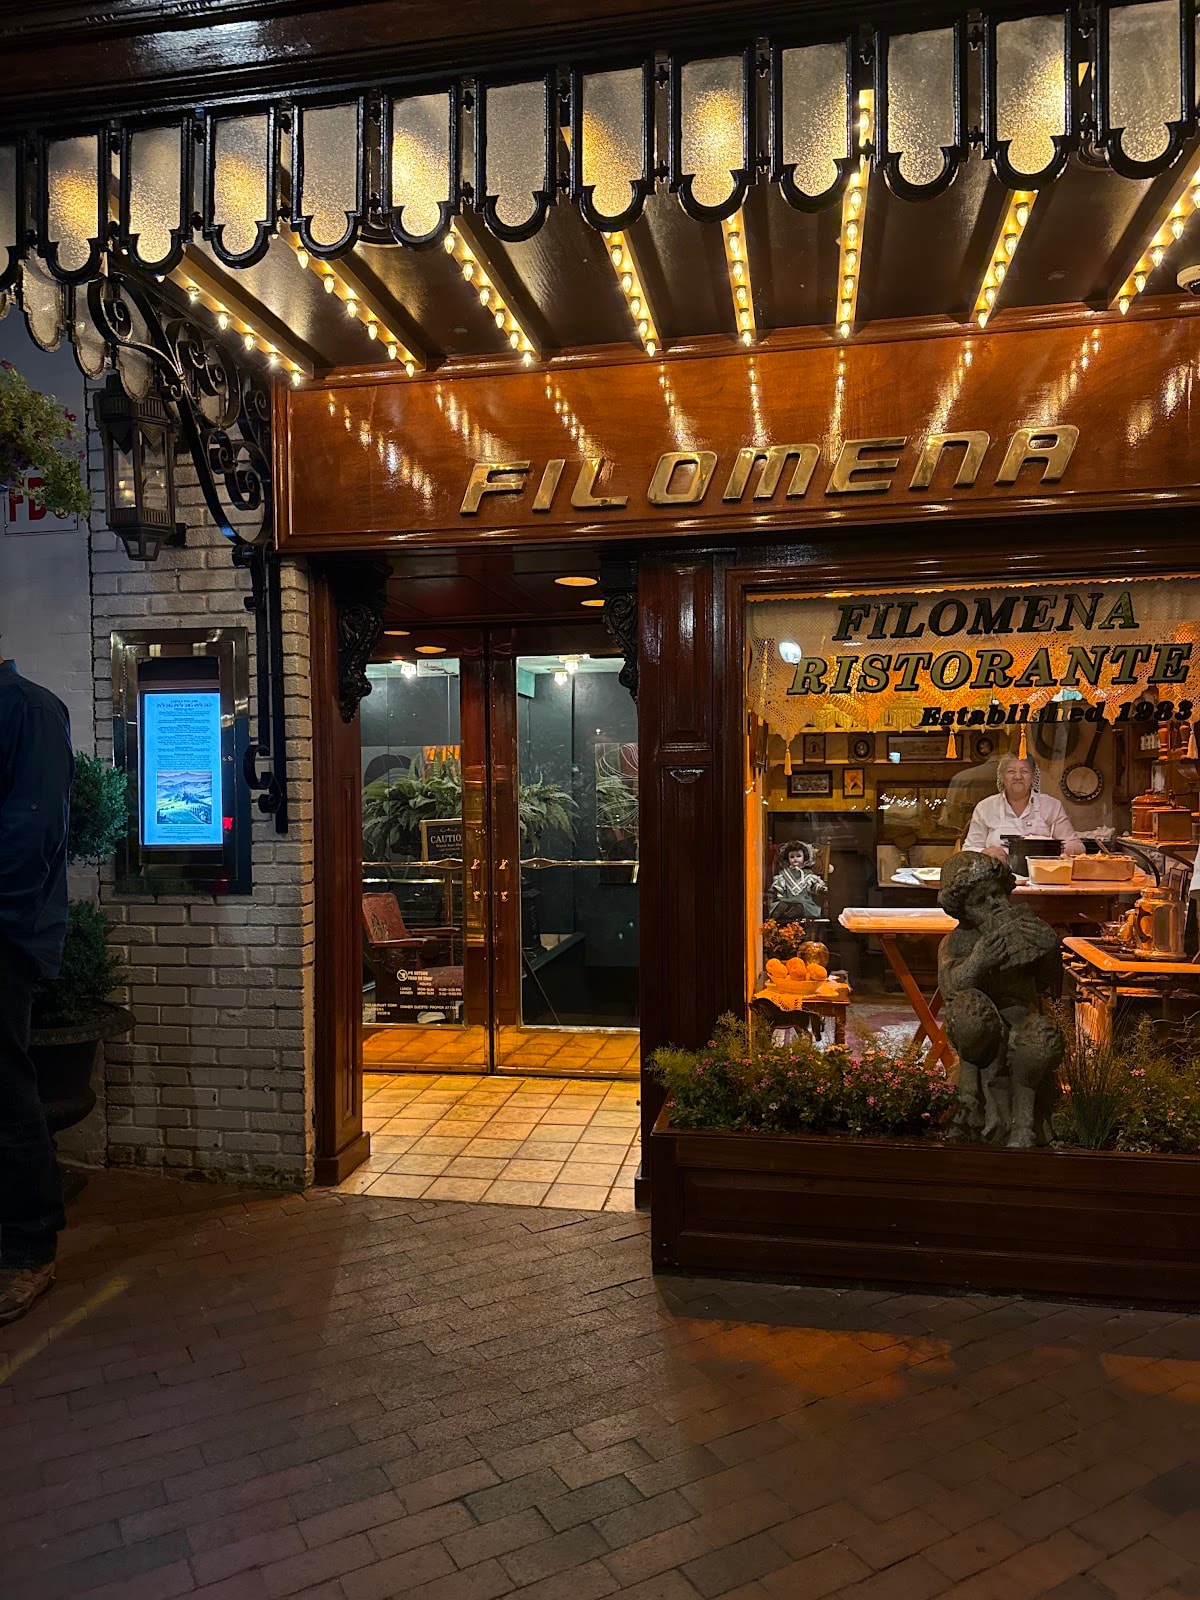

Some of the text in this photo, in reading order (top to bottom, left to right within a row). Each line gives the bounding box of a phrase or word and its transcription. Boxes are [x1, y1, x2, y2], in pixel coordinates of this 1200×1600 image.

[460, 424, 1079, 515] FILOMENA
[834, 591, 1138, 641] FILOMENA
[789, 643, 1192, 694] RISTORANTE
[920, 700, 1193, 726] Established 1983
